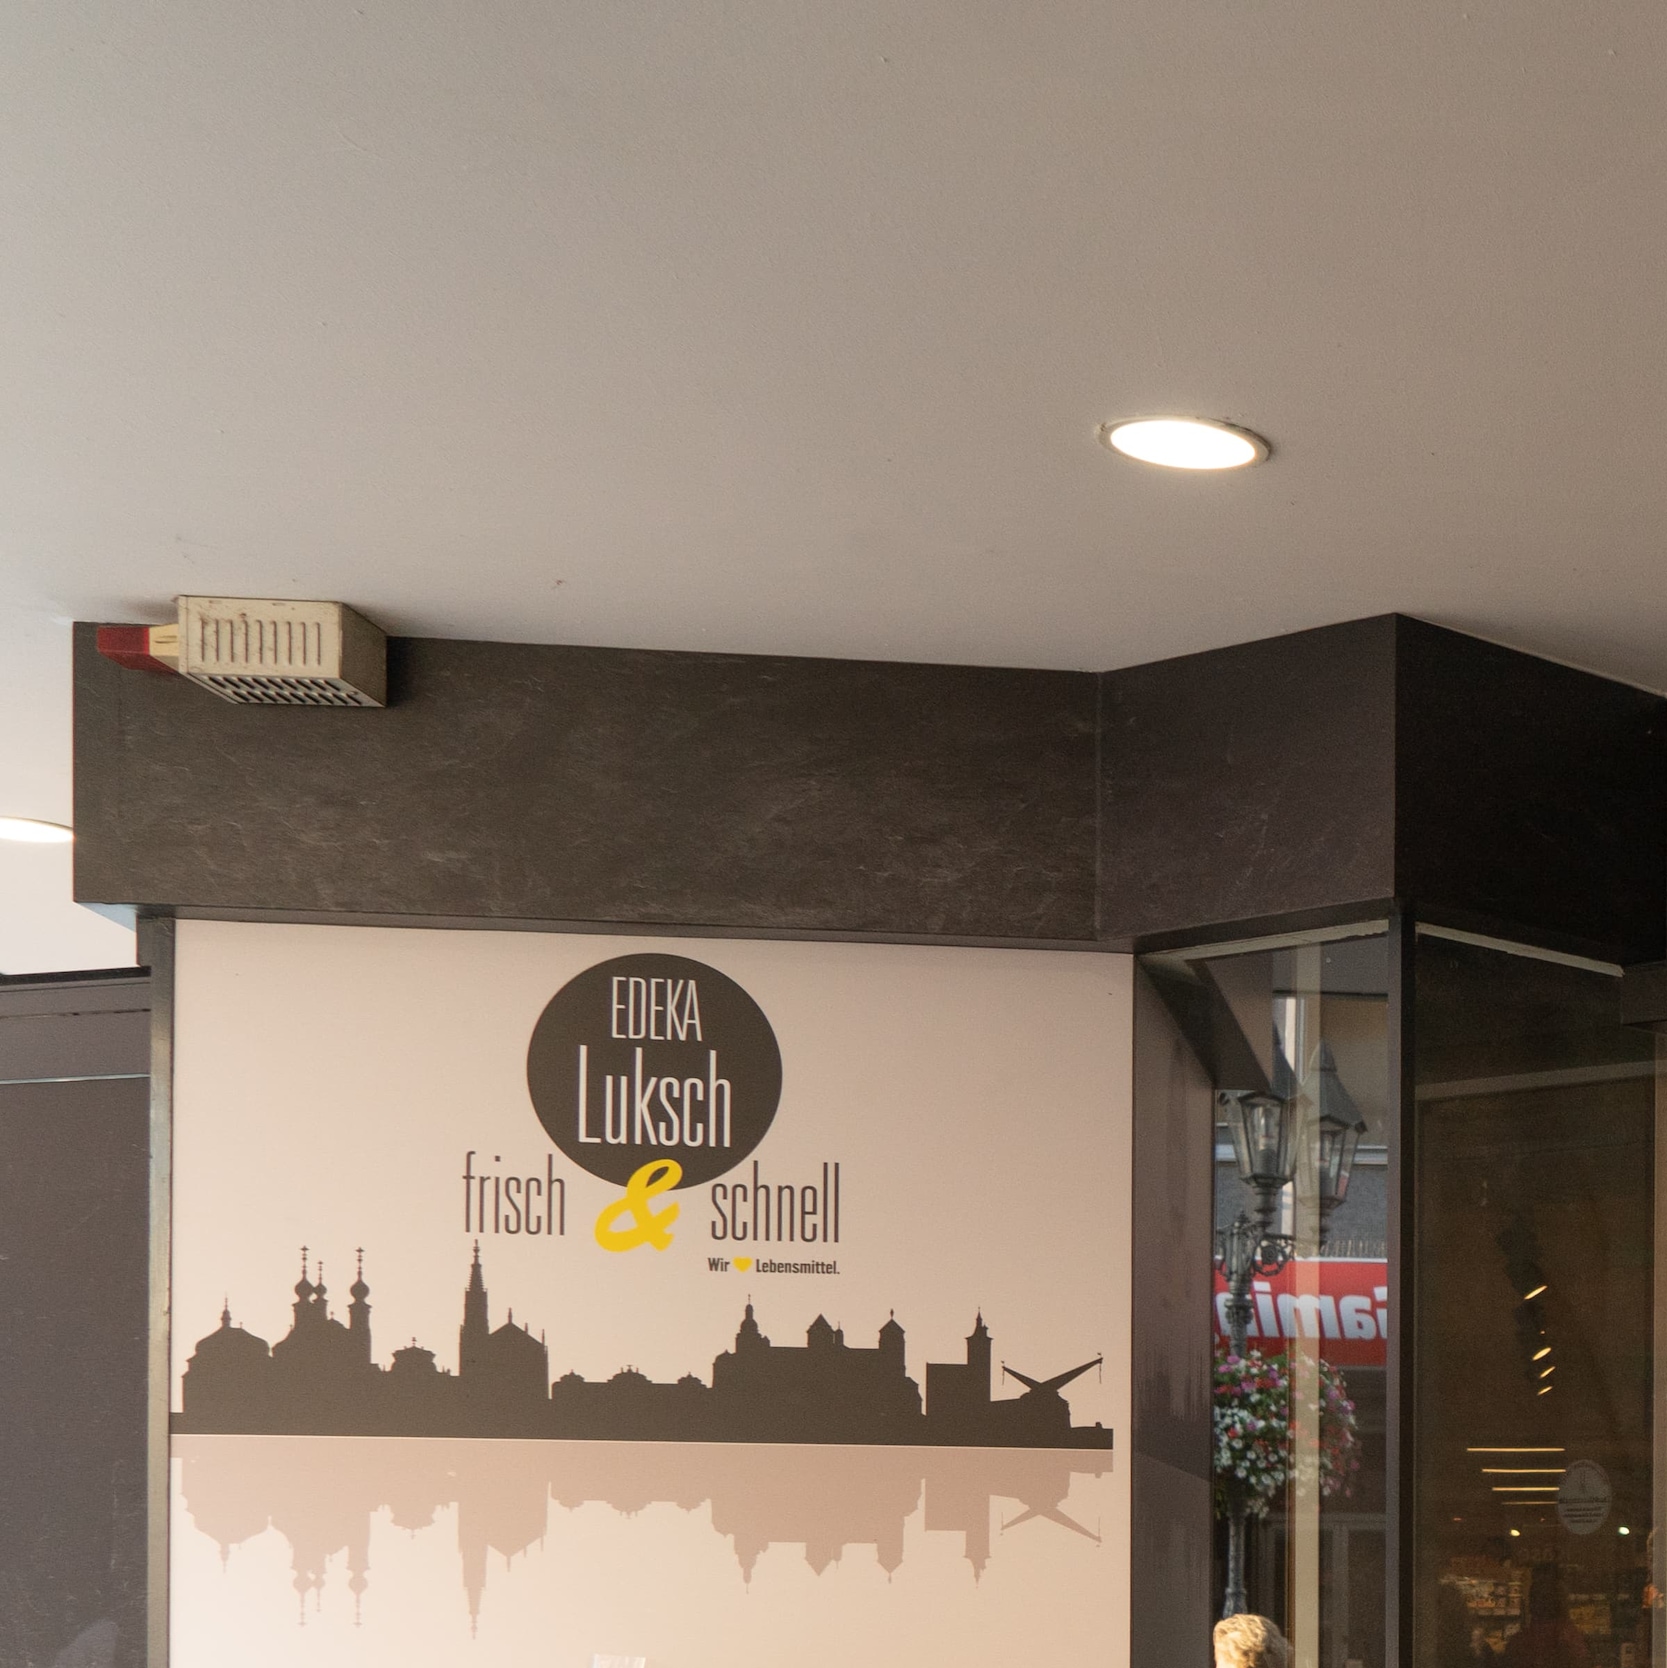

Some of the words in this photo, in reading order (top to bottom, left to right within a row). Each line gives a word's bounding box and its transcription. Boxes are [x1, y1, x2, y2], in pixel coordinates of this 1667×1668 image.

[610, 975, 703, 1042] EDEKA
[577, 1043, 732, 1148] Luksch
[462, 1150, 566, 1236] frisch
[594, 1158, 684, 1253] &
[710, 1159, 840, 1244] schnell
[707, 1257, 731, 1273] Wir
[755, 1257, 841, 1275] Lebensmittel.
